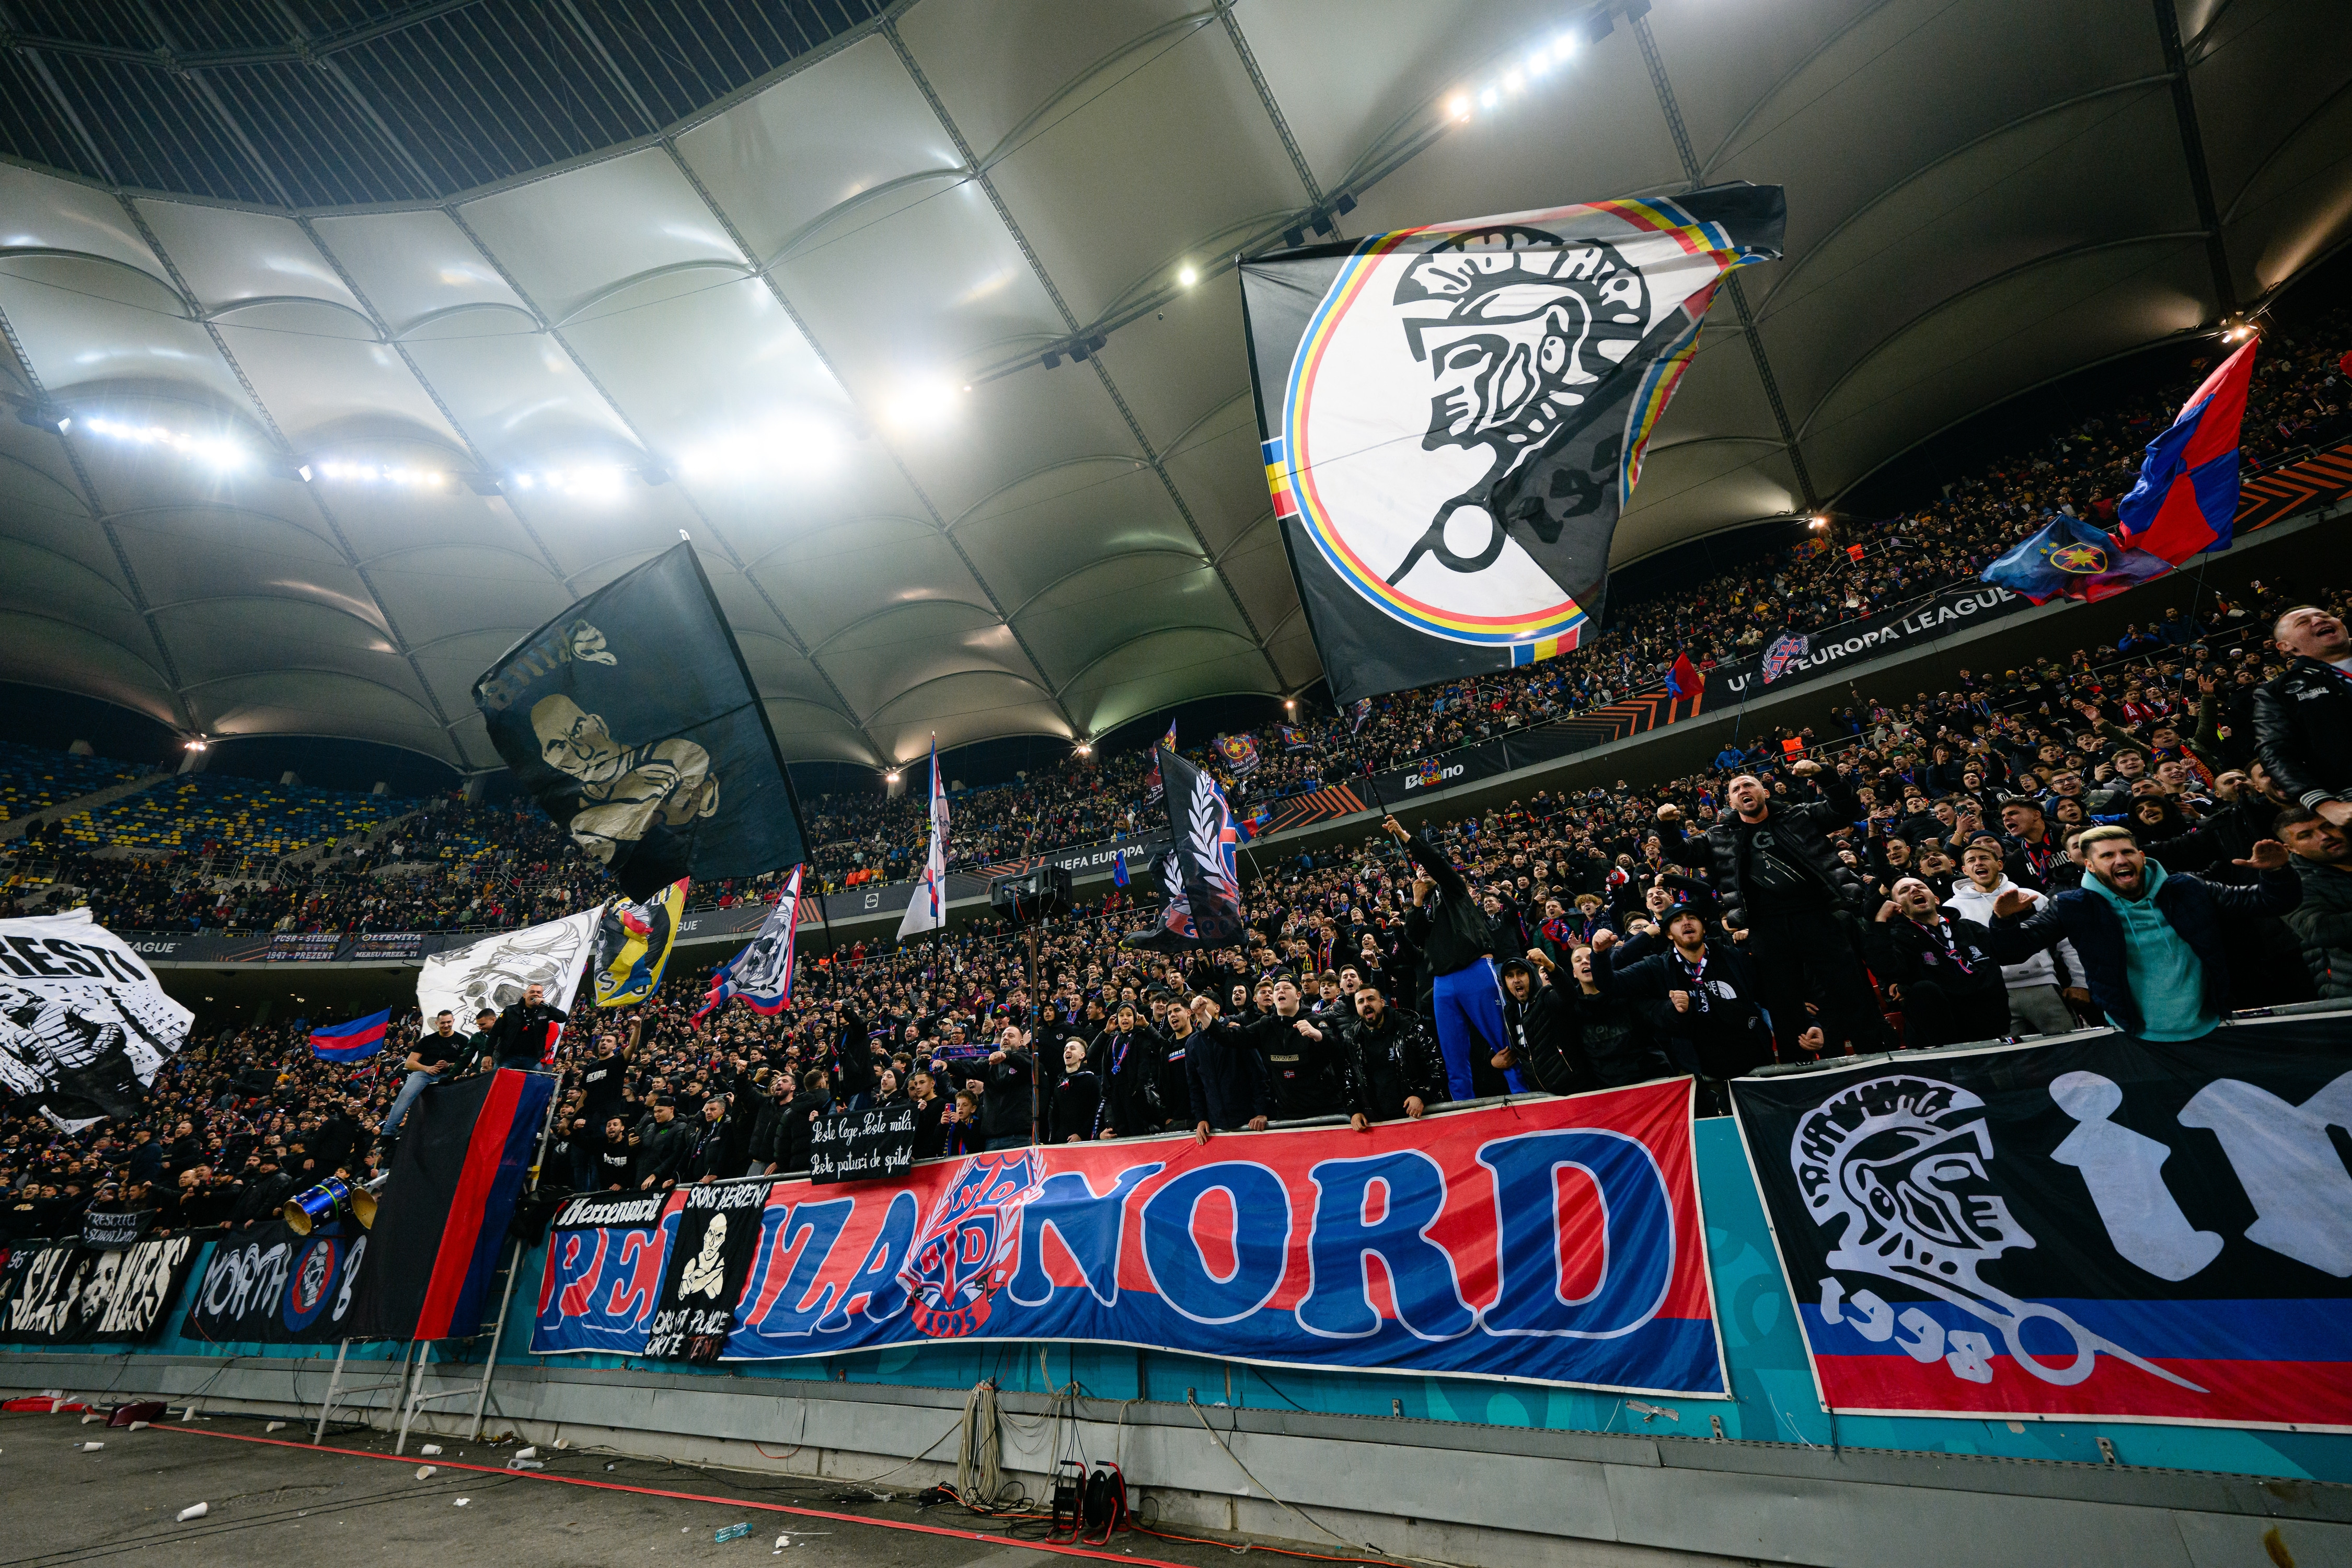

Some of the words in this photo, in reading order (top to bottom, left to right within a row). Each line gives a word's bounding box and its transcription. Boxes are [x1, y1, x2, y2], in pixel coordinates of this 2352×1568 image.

[1798, 627, 1900, 672] EUROPA
[1903, 587, 2015, 635] LEAGUE
[1405, 764, 1463, 790] Beno
[1422, 774, 1443, 784] FCSB
[811, 1119, 836, 1144] Peste
[862, 1111, 886, 1135] Peste
[811, 1153, 835, 1175] Peste
[837, 1151, 868, 1180] paturi
[870, 1148, 881, 1168] de
[885, 1145, 913, 1174] spital
[687, 1184, 722, 1209] SKINS
[714, 1180, 773, 1211] BERCENI
[543, 1190, 918, 1337] PEZA
[1008, 1127, 1675, 1342] NORD
[194, 1243, 292, 1323] NORTH
[687, 1309, 730, 1336] PLACE
[927, 1306, 976, 1336] 1995
[1819, 1277, 1996, 1385] 1998
